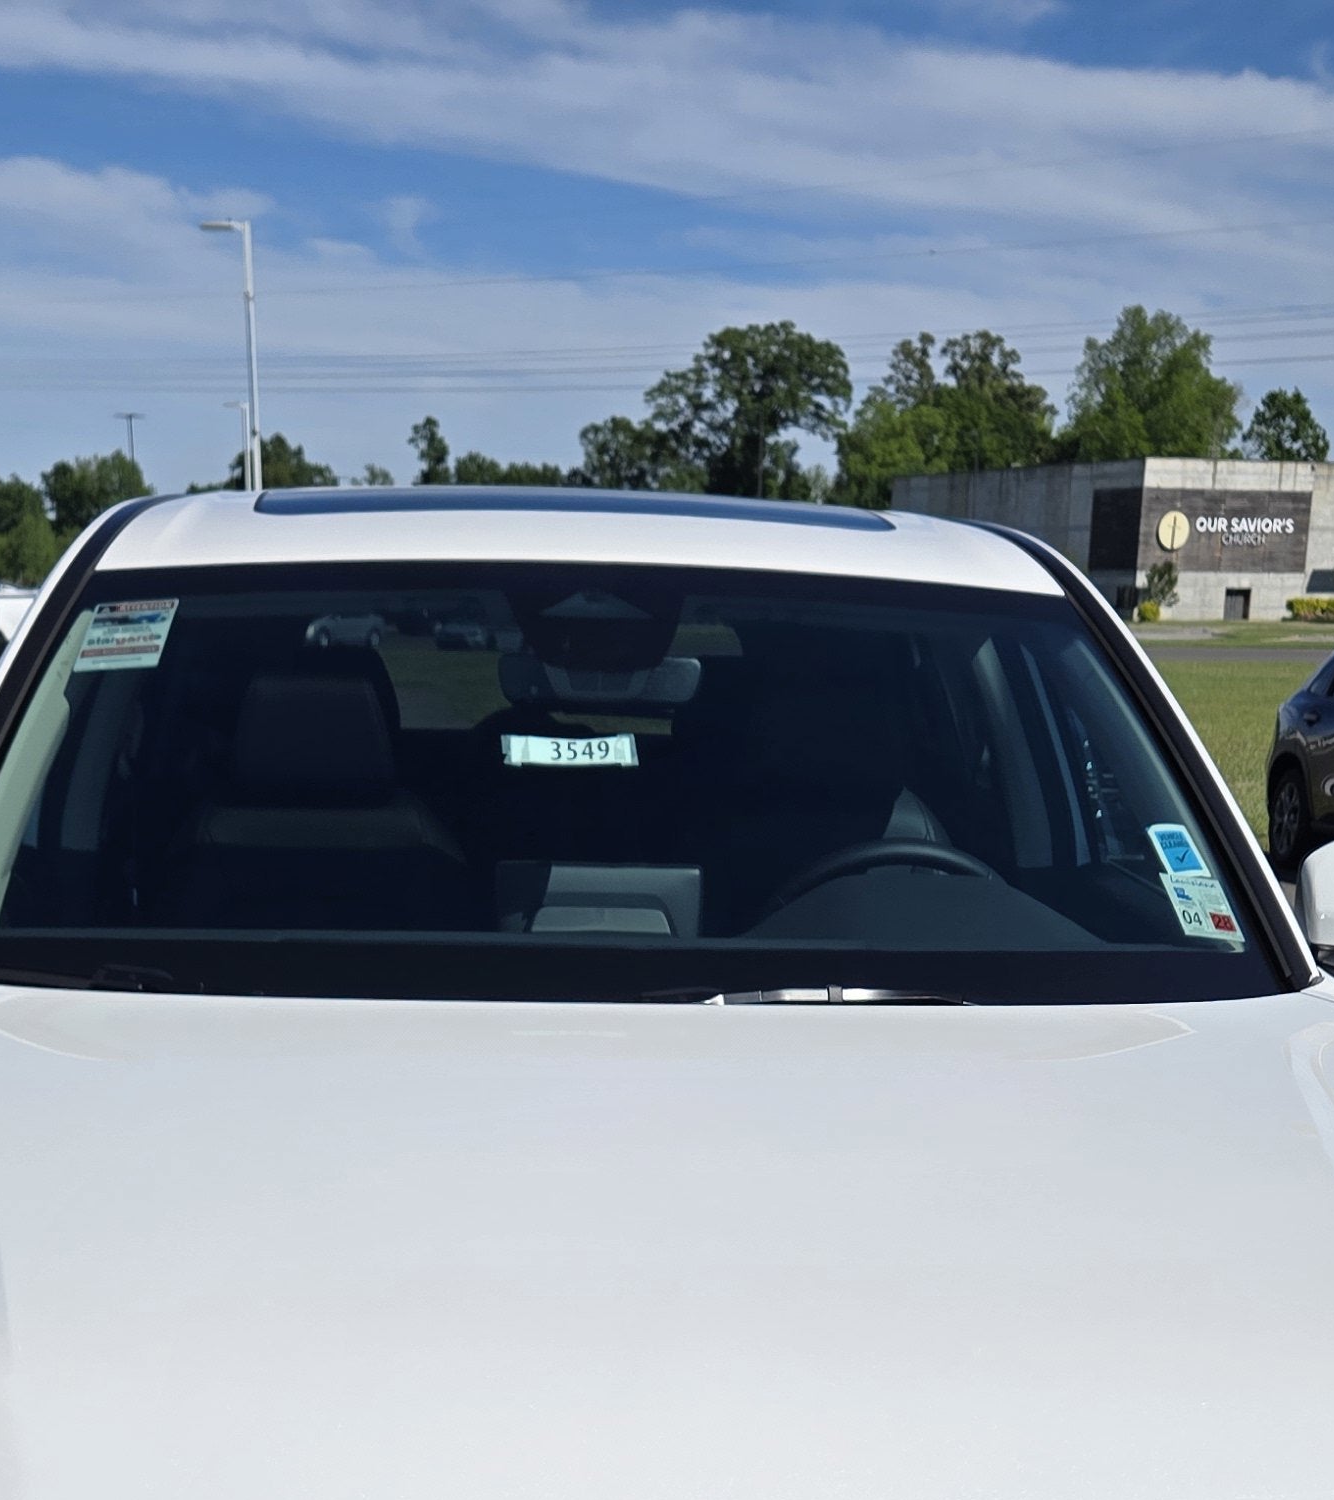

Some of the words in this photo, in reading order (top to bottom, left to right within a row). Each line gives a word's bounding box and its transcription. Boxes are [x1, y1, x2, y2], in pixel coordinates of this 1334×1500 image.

[1195, 516, 1229, 533] OUR
[1230, 516, 1295, 534] SAVIOR'S
[1222, 533, 1266, 546] CHURCH
[550, 740, 610, 761] 3549
[1182, 909, 1203, 927] 04
